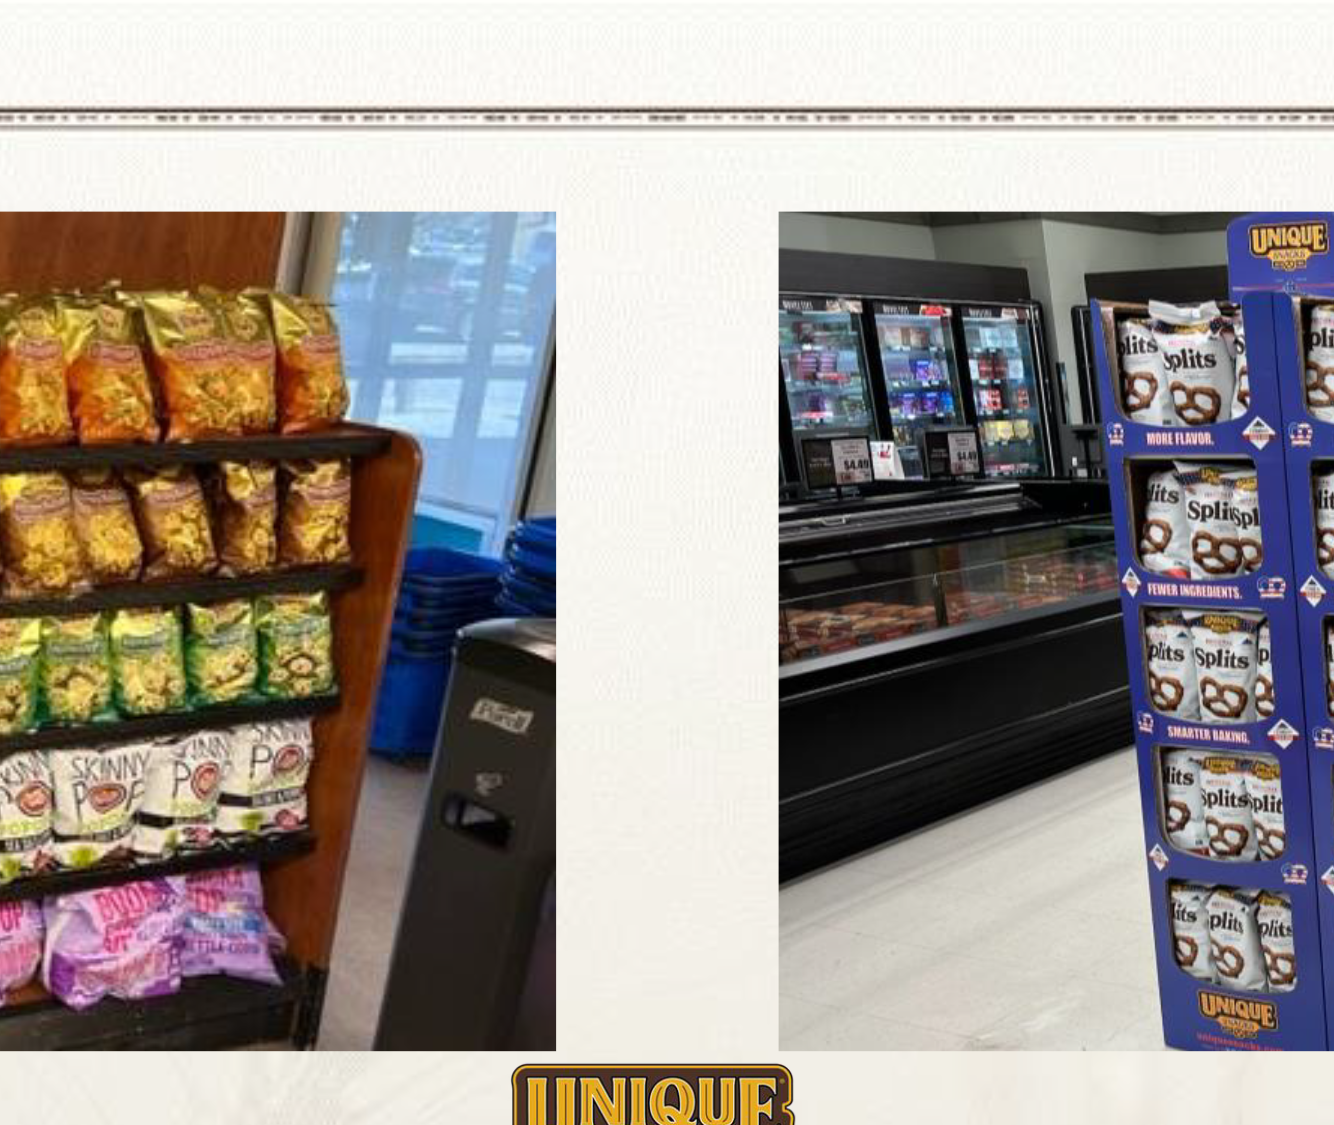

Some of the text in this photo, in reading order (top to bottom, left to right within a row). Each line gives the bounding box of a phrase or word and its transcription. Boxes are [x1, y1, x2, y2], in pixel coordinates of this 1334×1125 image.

[1251, 225, 1327, 255] UNIQUE
[1164, 348, 1218, 372] Splits
[1146, 432, 1215, 447] MORE FLAVOR.
[1147, 583, 1243, 600] FEWER INGREDIENTS.
[1194, 646, 1250, 670] Splits
[1168, 725, 1251, 745] SMARTER BAKING.
[71, 750, 151, 781] SKINNY
[1200, 992, 1276, 1030] UNIQUE
